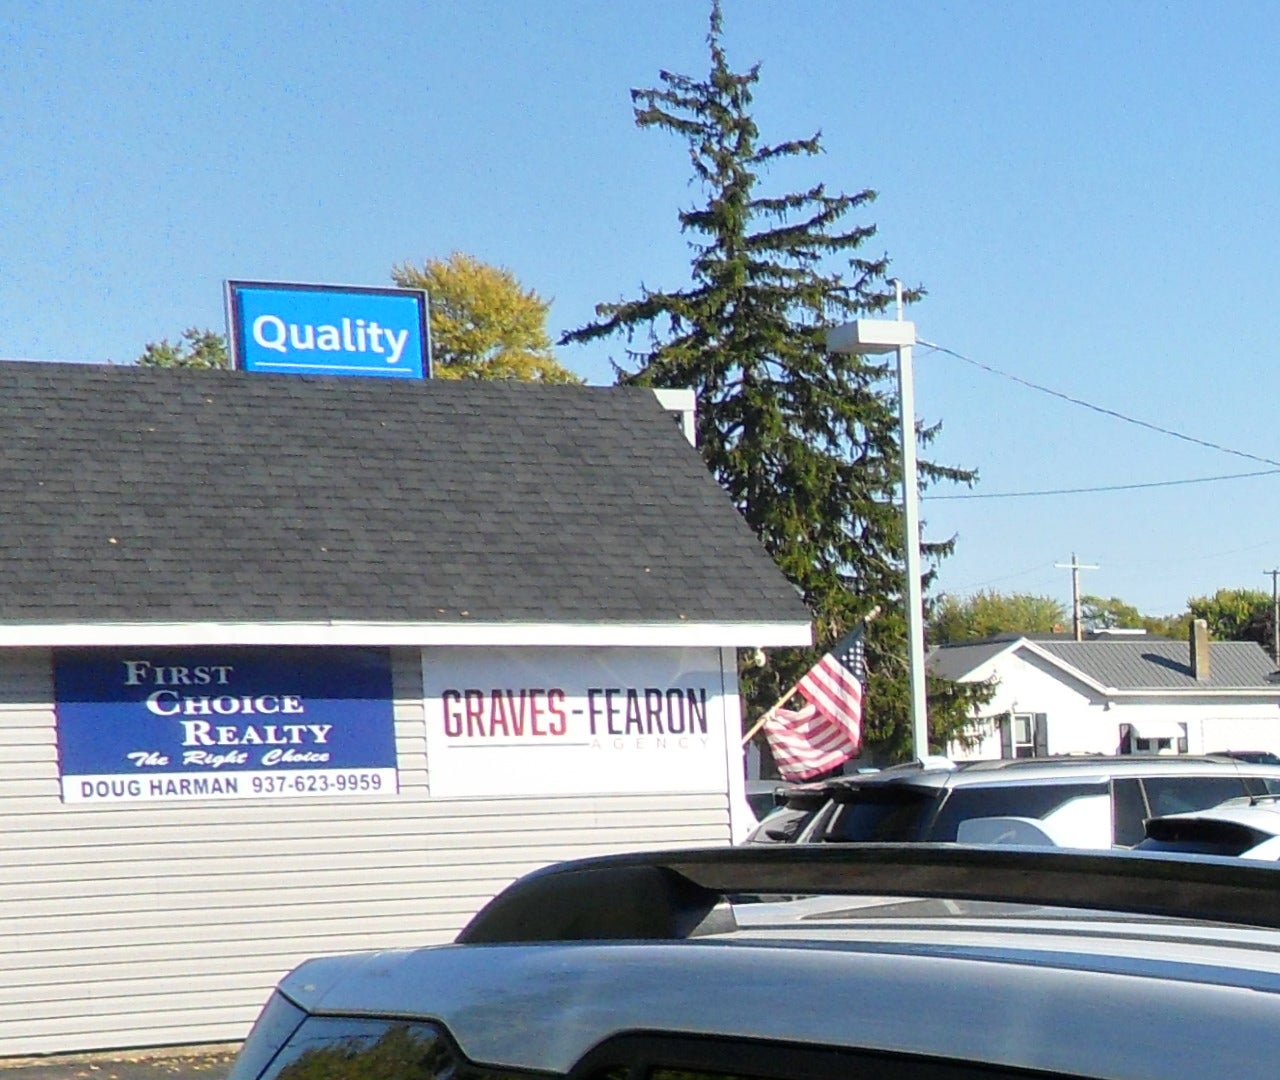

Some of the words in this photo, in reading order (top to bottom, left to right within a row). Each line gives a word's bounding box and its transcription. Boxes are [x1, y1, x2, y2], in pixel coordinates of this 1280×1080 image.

[253, 315, 409, 364] Quality
[123, 660, 234, 686] FIRST
[146, 689, 304, 716] CHOICE
[442, 687, 708, 737] GRAVES-FEARON
[182, 720, 333, 746] REALTY
[591, 737, 709, 750] AGENCY
[127, 751, 170, 767] The
[182, 750, 248, 768] Right
[262, 748, 330, 766] Choice
[81, 780, 142, 798] DOUG
[150, 777, 239, 796] HARMAN
[252, 773, 382, 793] 937-623-9959
